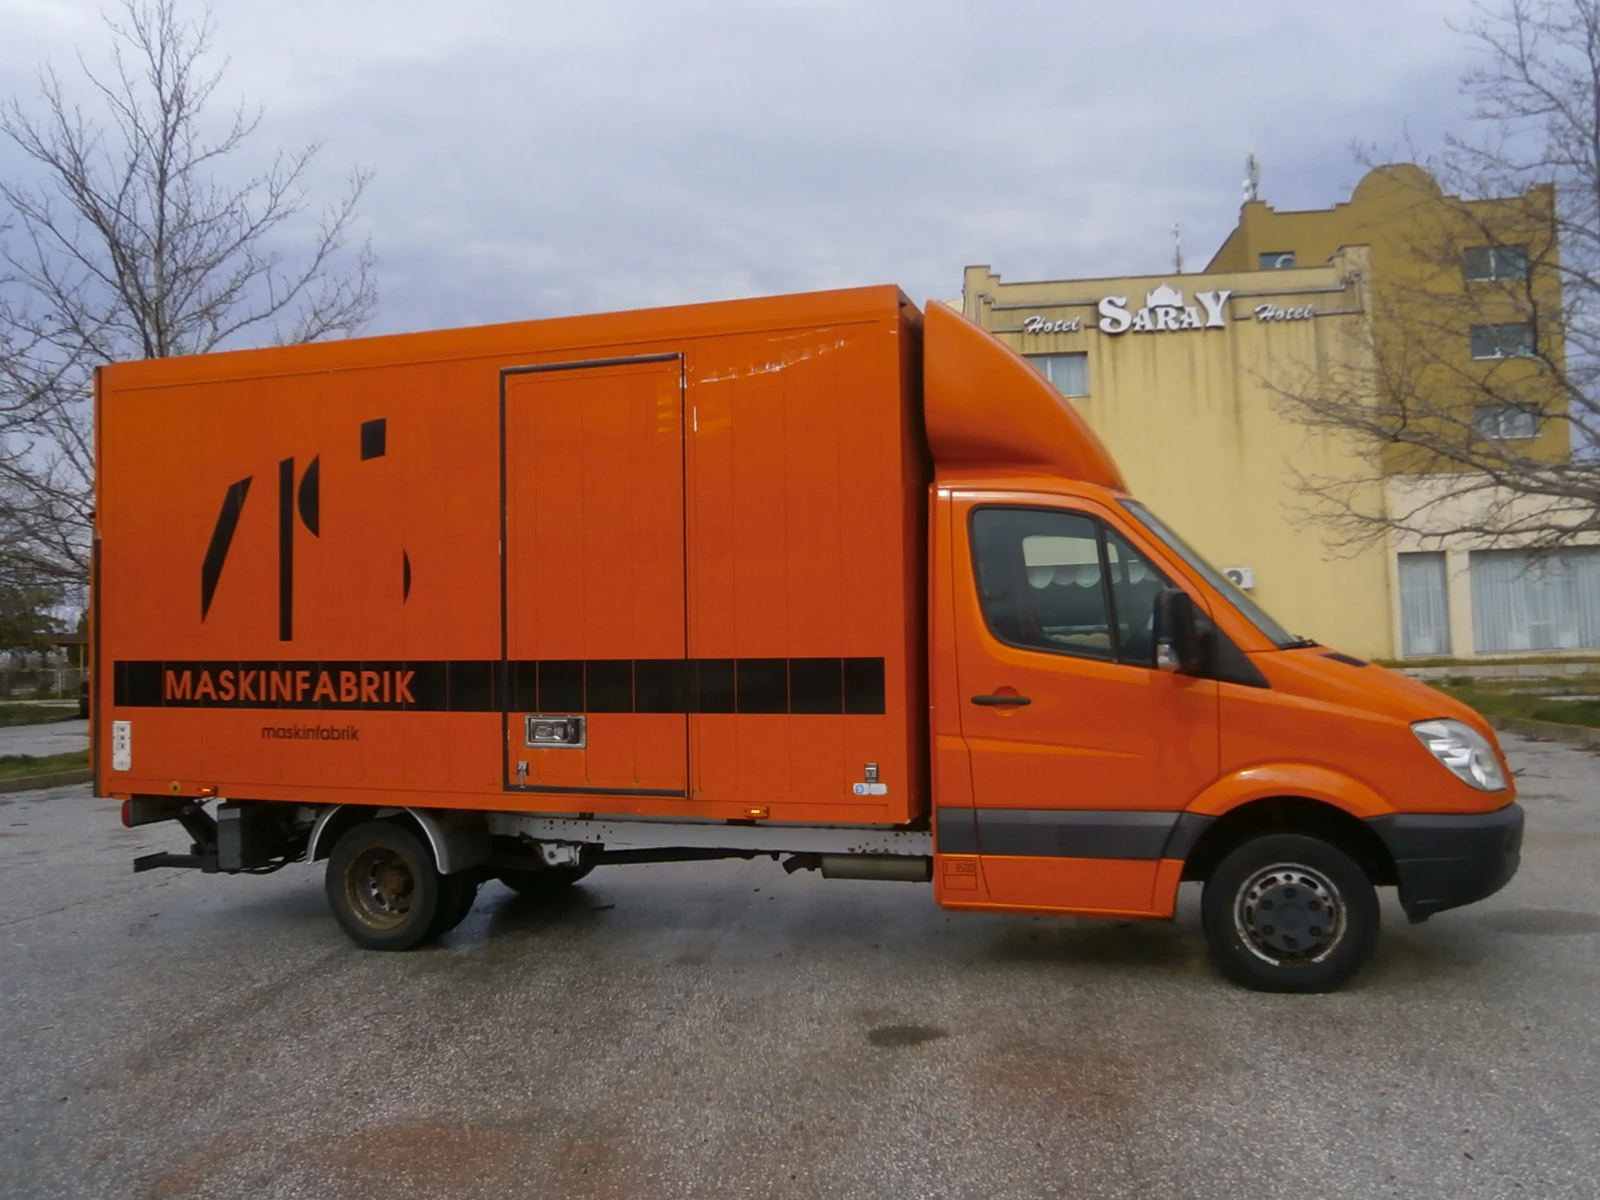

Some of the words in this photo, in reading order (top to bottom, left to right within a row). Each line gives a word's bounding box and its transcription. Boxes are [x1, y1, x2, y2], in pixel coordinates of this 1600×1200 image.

[1023, 315, 1080, 334] Hotel
[1253, 303, 1313, 321] Hotel
[165, 669, 416, 703] MASKINFABRIK
[261, 725, 360, 741] maskinfabrik
